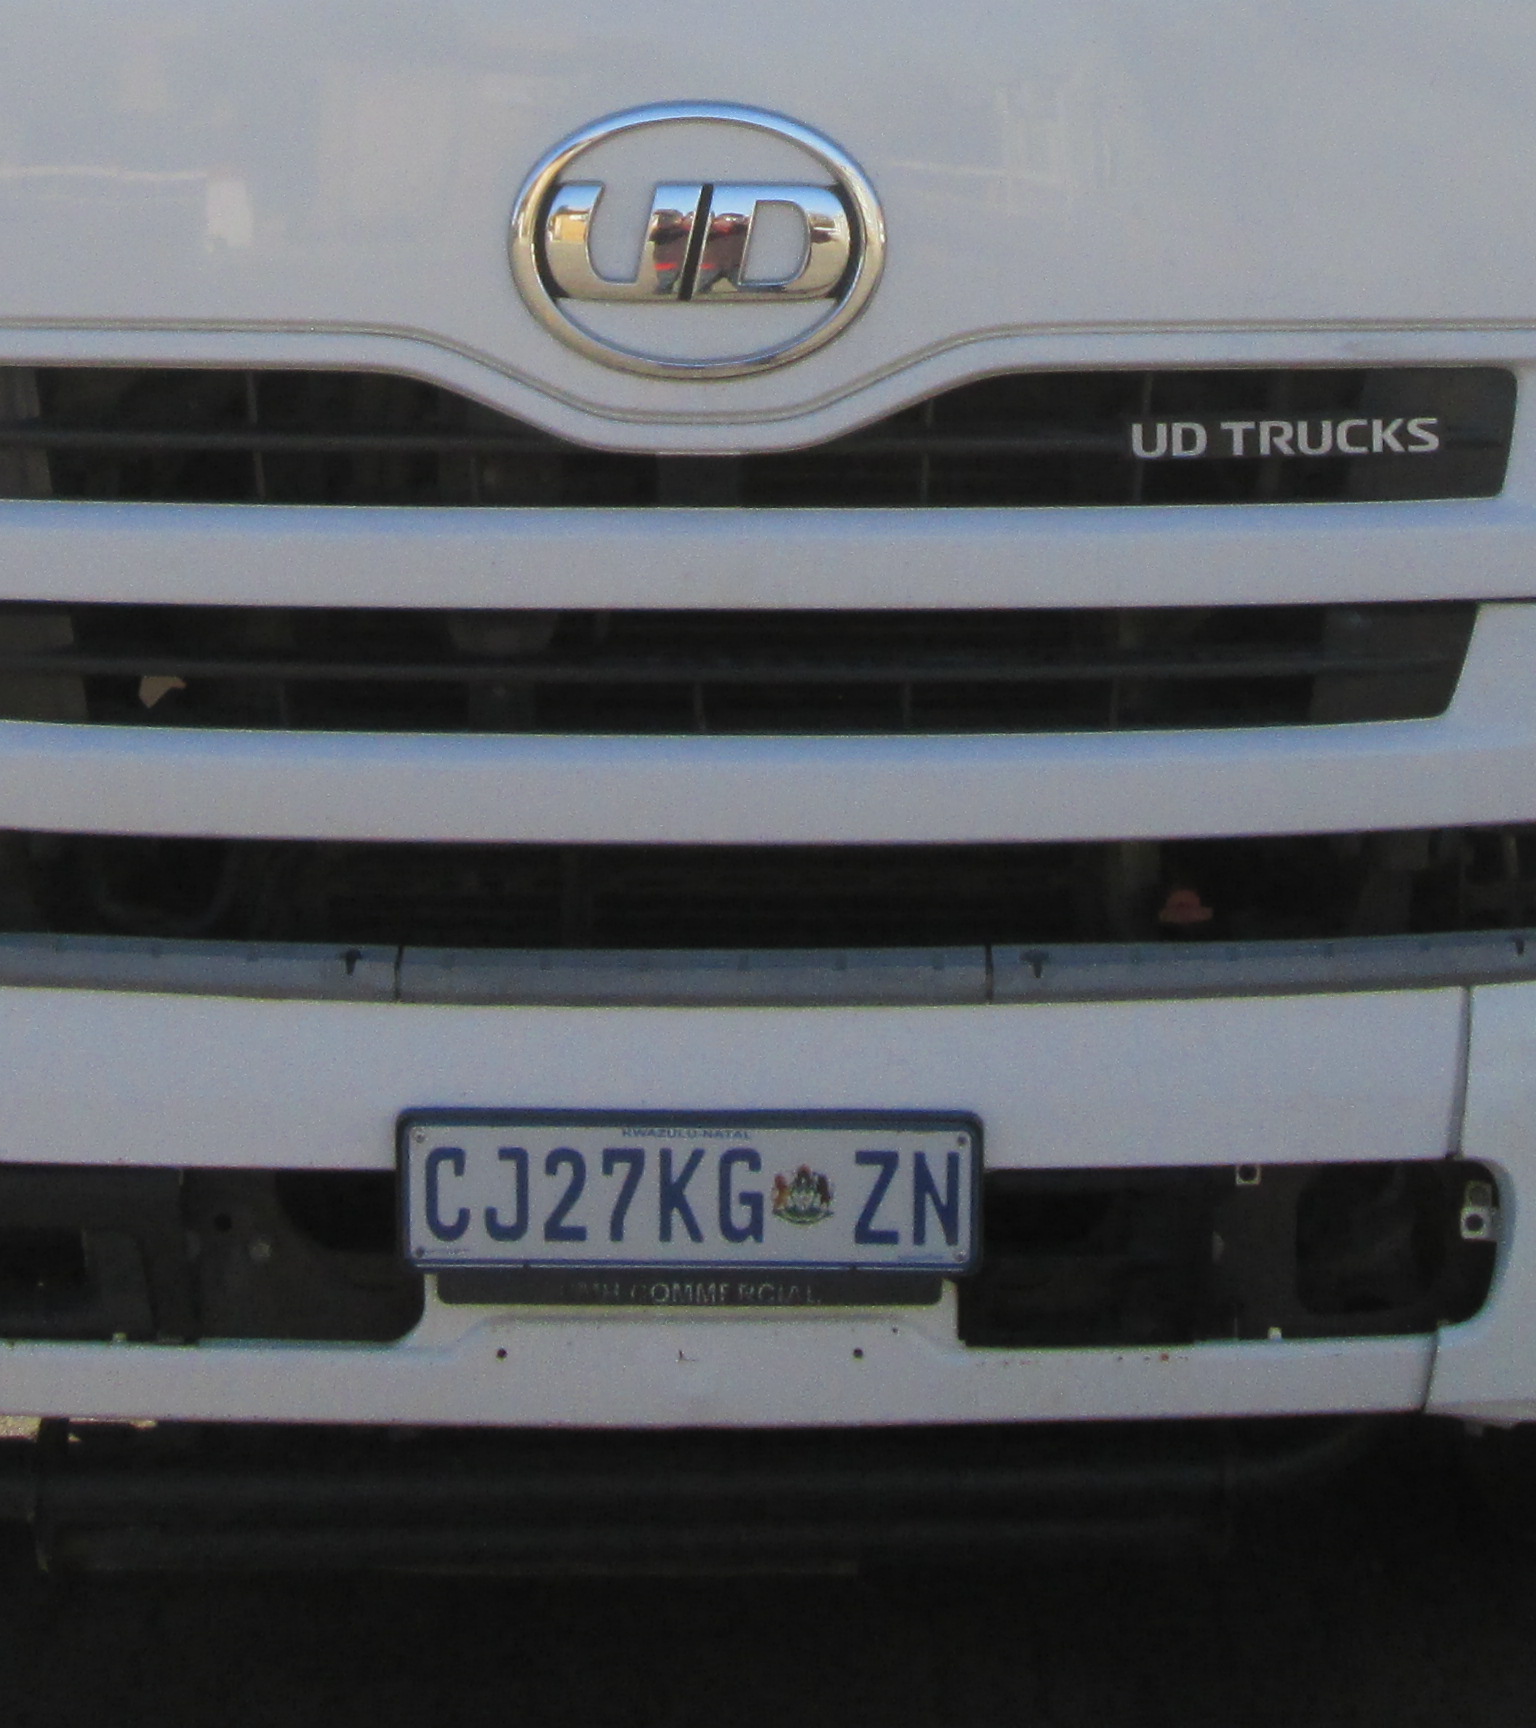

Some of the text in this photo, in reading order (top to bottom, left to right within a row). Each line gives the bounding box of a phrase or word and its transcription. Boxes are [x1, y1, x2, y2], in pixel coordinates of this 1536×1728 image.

[544, 180, 850, 301] UD
[1131, 418, 1439, 458] UD TRUCKS
[425, 1146, 961, 1245] CJ27KG ZN
